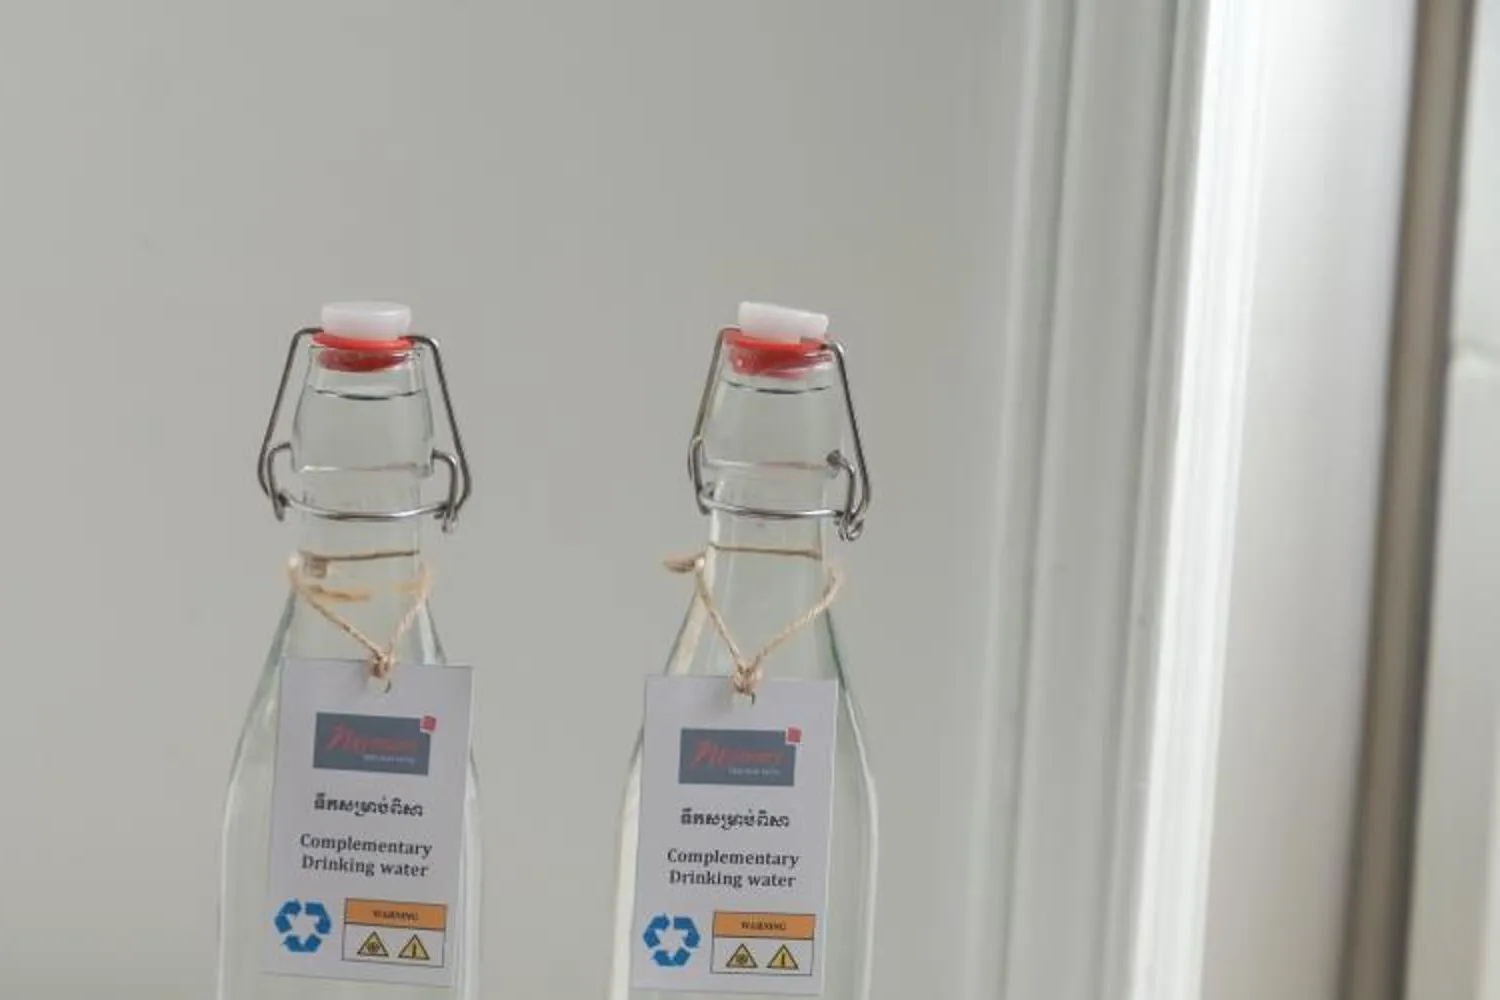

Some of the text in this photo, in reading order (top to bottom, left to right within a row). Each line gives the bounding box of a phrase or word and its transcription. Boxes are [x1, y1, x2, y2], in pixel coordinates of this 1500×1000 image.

[300, 833, 433, 860] Complementary
[301, 854, 430, 878] Drinking water
[667, 848, 800, 868] Complementary
[669, 869, 797, 889] Drinking water
